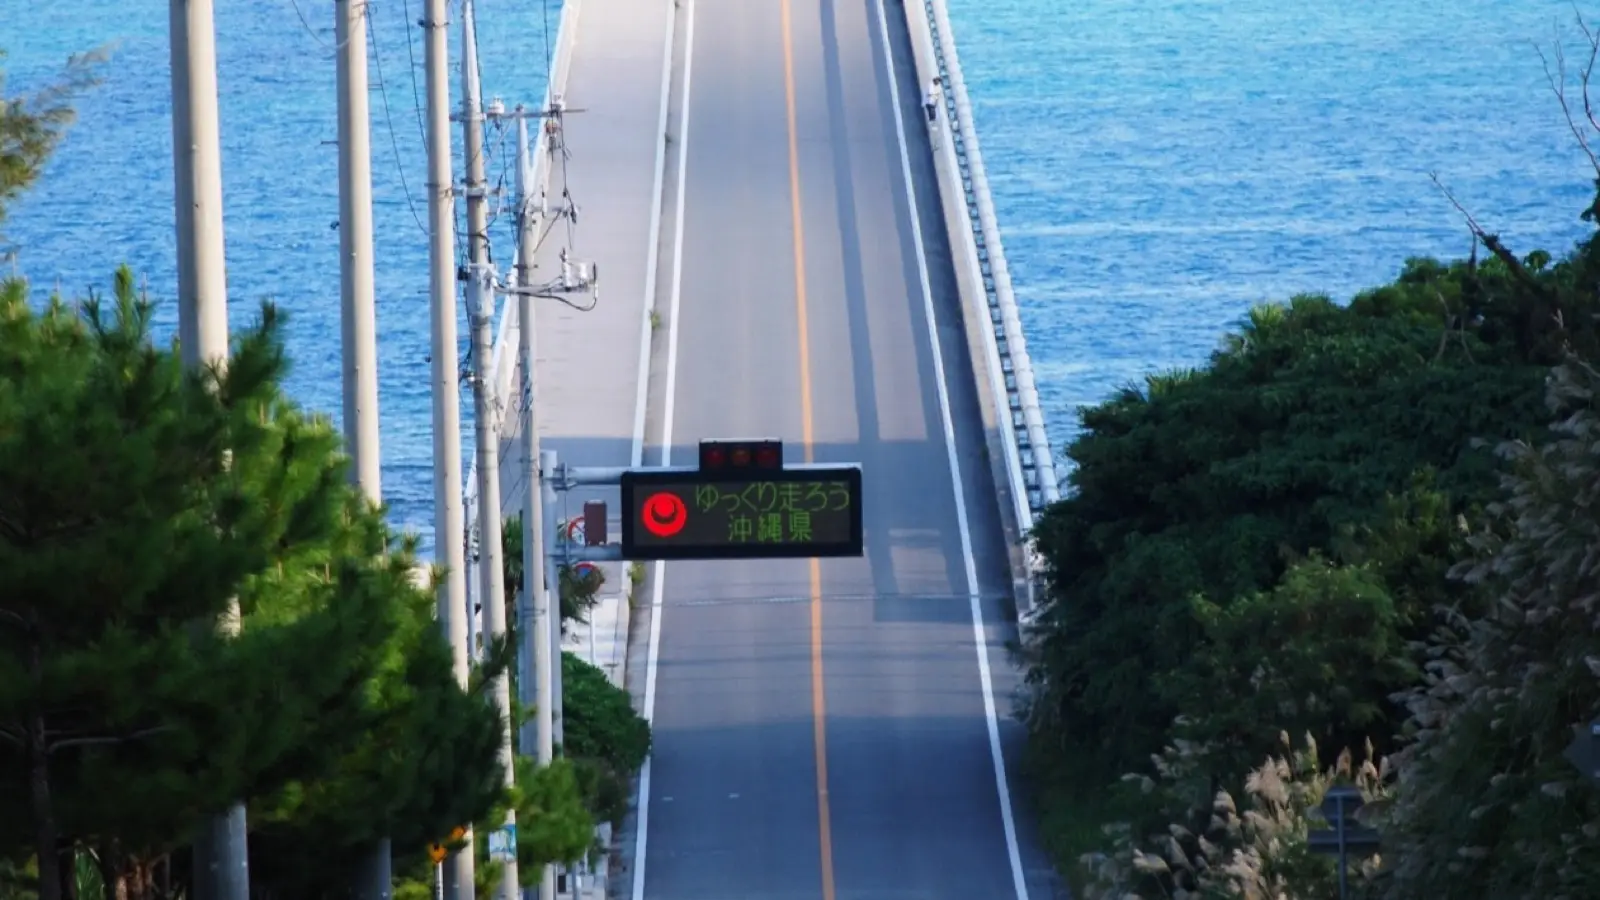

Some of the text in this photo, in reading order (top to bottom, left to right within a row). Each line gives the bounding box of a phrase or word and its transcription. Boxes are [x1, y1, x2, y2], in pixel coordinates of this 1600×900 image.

[695, 481, 850, 512] ゆっくり走ろう
[728, 511, 813, 541] 沖縄県
